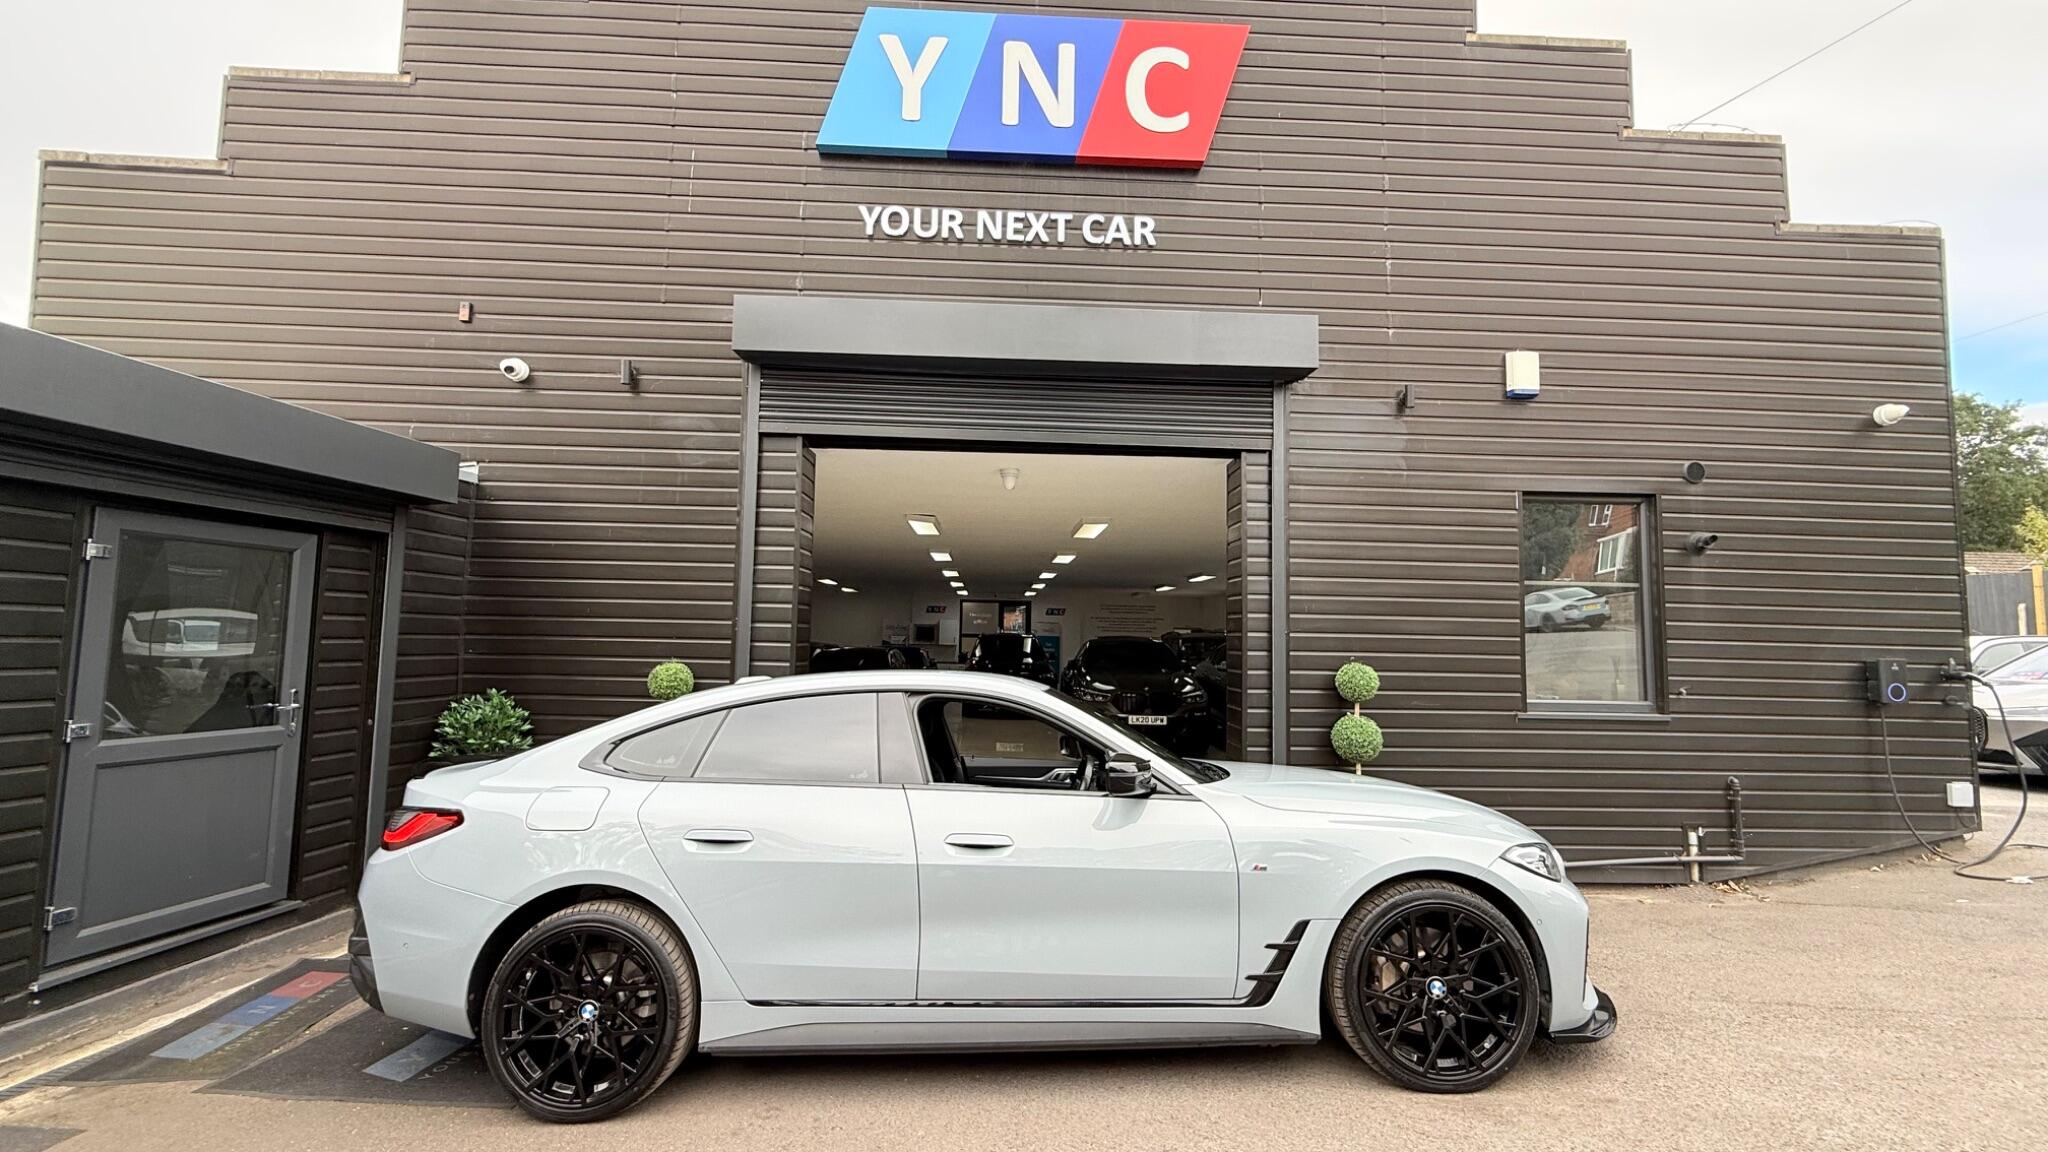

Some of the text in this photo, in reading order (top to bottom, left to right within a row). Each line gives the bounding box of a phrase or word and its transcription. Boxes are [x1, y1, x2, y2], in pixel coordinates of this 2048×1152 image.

[879, 34, 1191, 133] YNC
[858, 204, 1157, 247] YOUR NEXT CAR
[1131, 716, 1164, 724] LK20 UPW
